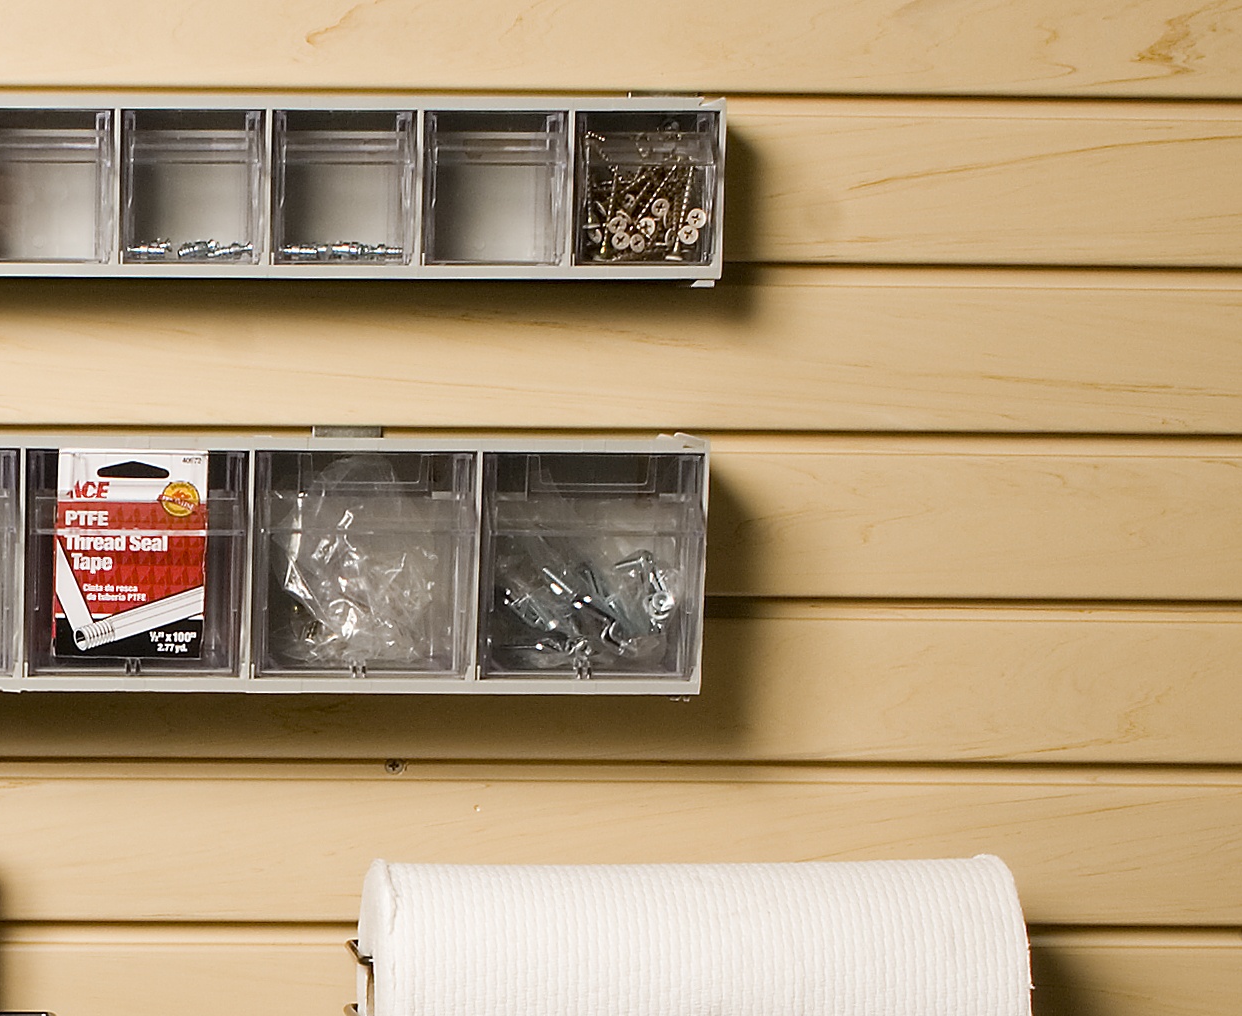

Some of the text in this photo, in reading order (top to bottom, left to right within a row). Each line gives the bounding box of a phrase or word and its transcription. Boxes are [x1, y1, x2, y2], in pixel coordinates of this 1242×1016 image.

[66, 481, 110, 498] ACE
[65, 510, 109, 526] PTFE
[65, 532, 168, 552] Thread Seal
[71, 552, 113, 574] Tape
